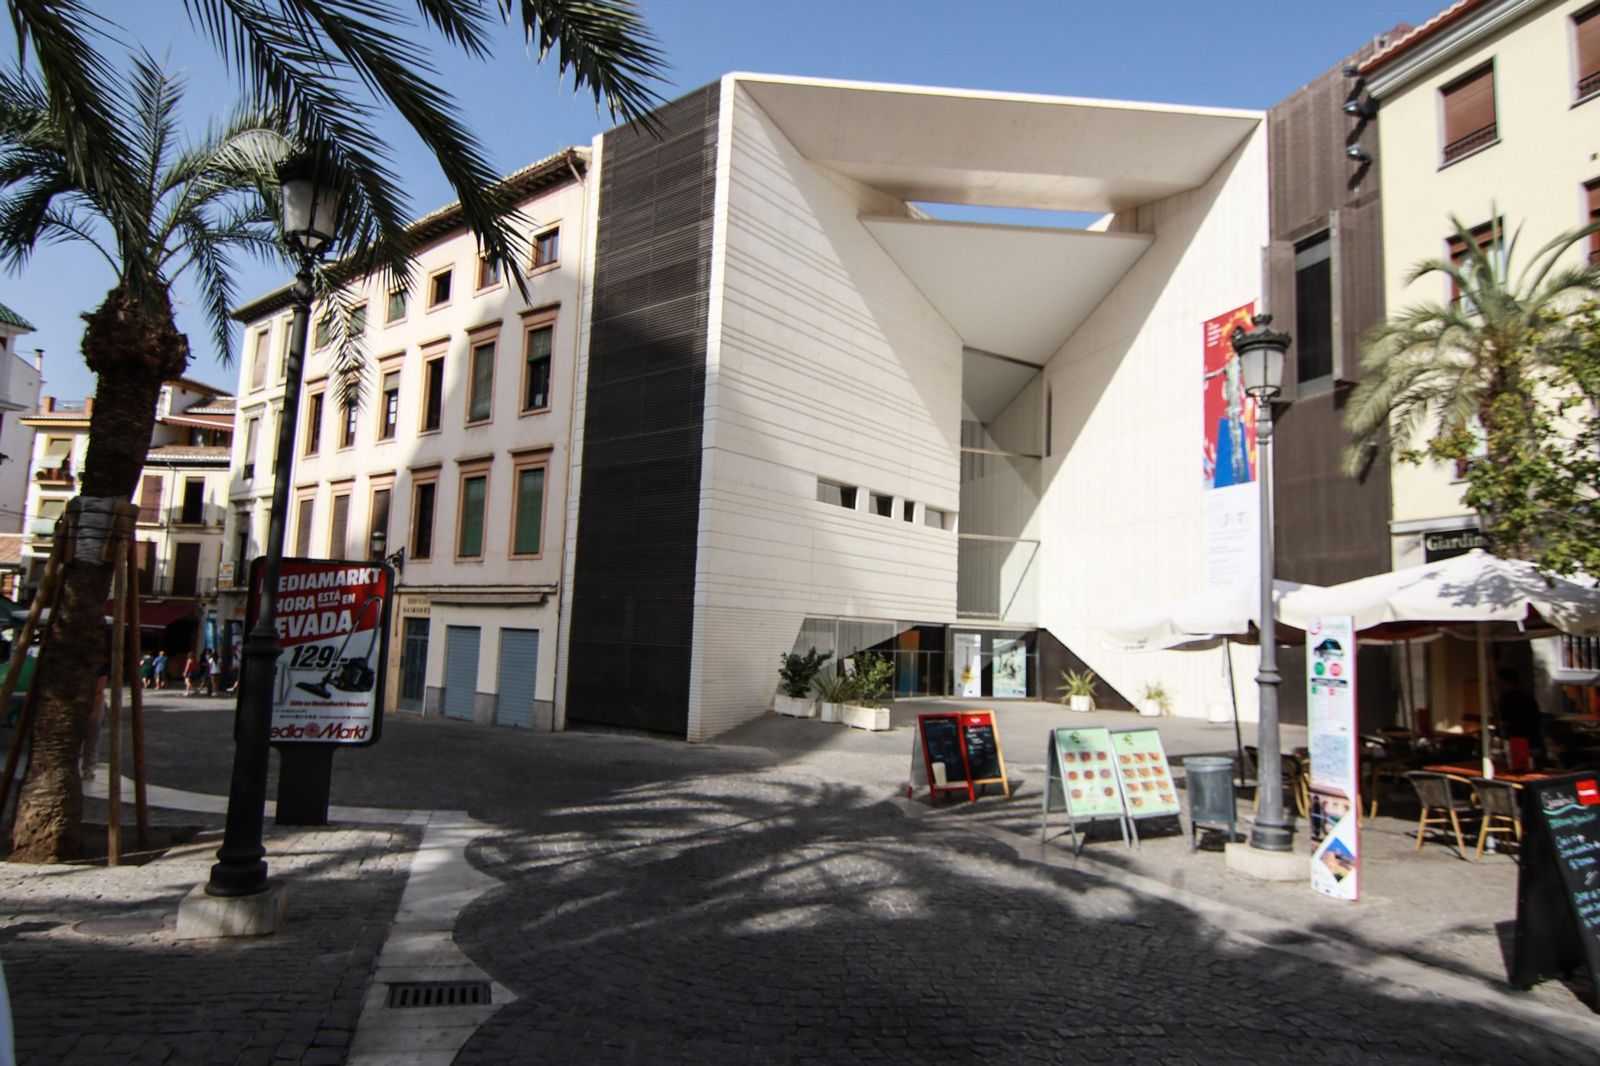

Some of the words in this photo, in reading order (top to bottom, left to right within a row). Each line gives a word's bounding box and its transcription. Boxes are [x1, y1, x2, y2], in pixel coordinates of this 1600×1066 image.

[260, 568, 381, 593] EDIAMARKT
[318, 590, 341, 602] ESTÁ
[342, 593, 357, 605] EN
[274, 609, 353, 639] EVADA
[271, 723, 305, 739] edia
[317, 722, 369, 739] Markt
